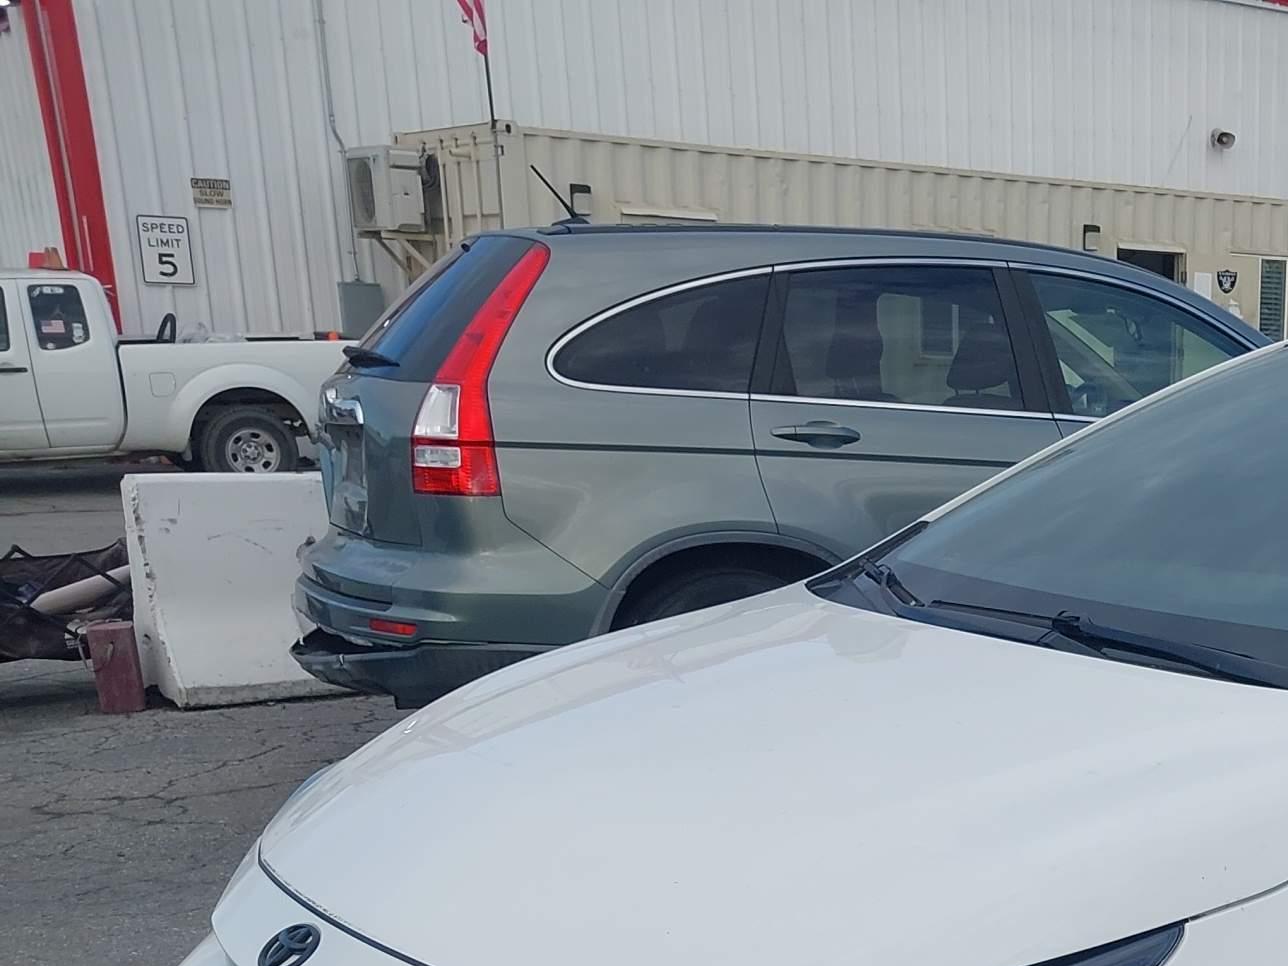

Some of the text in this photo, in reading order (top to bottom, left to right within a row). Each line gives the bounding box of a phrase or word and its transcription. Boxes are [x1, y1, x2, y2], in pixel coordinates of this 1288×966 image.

[142, 222, 185, 234] SPEED
[147, 238, 182, 248] LIMIT
[158, 253, 178, 277] 5
